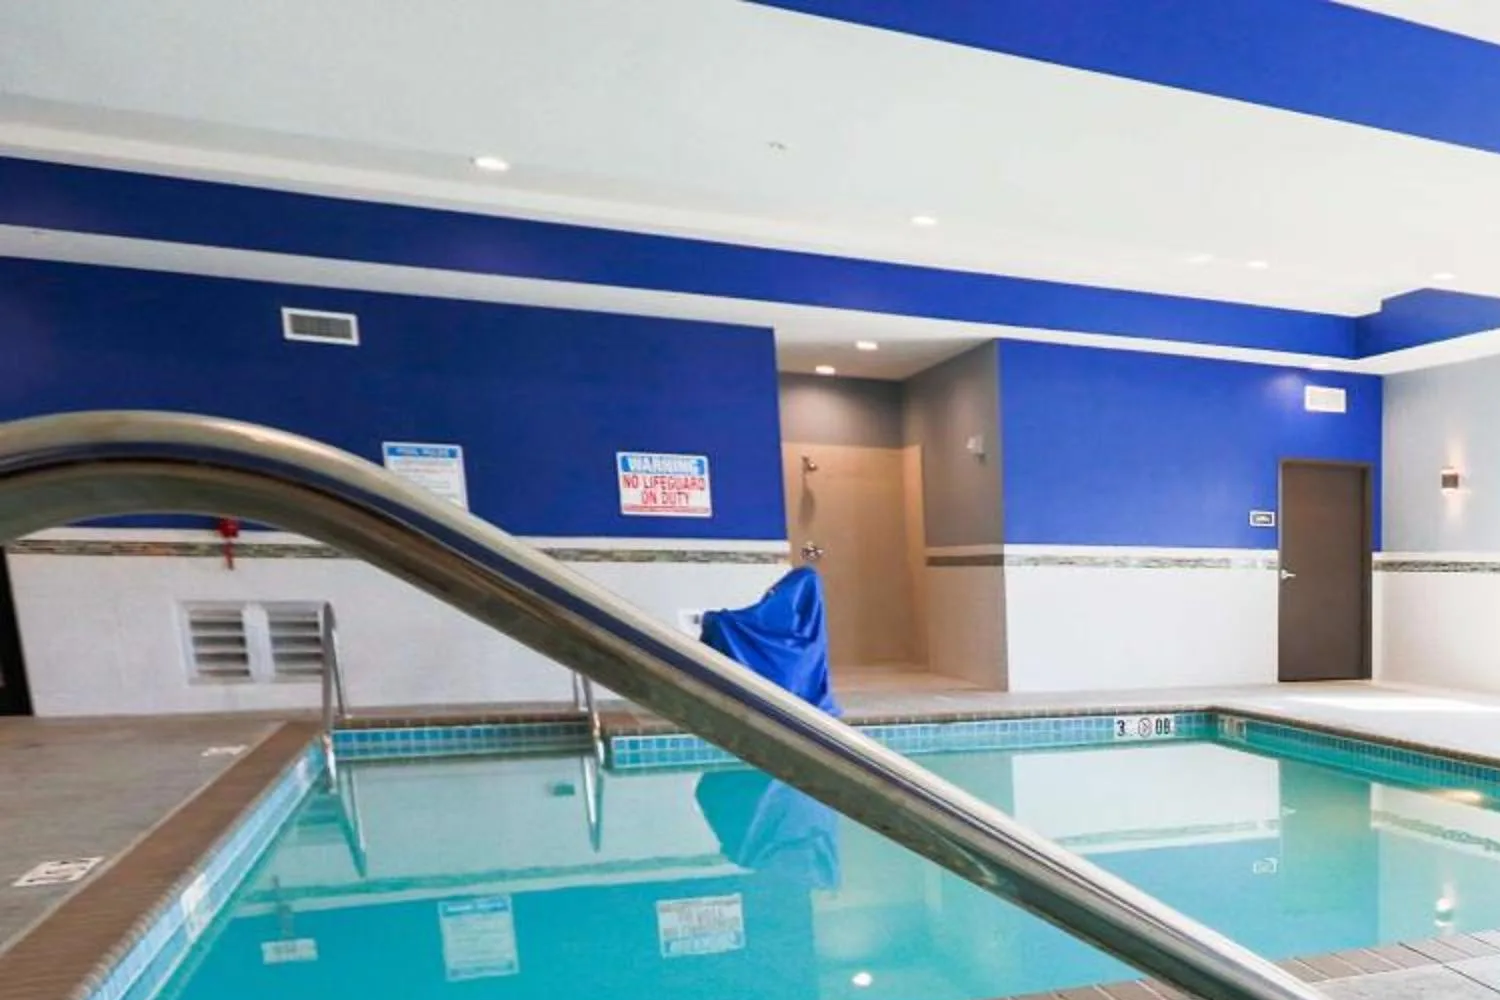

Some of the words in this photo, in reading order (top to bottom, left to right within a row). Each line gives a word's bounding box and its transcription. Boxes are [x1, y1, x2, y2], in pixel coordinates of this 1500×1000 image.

[629, 456, 699, 473] WARNING
[623, 475, 639, 489] NO
[643, 475, 705, 491] LIFEGUARD
[642, 490, 657, 505] ON
[661, 491, 688, 505] DUTY
